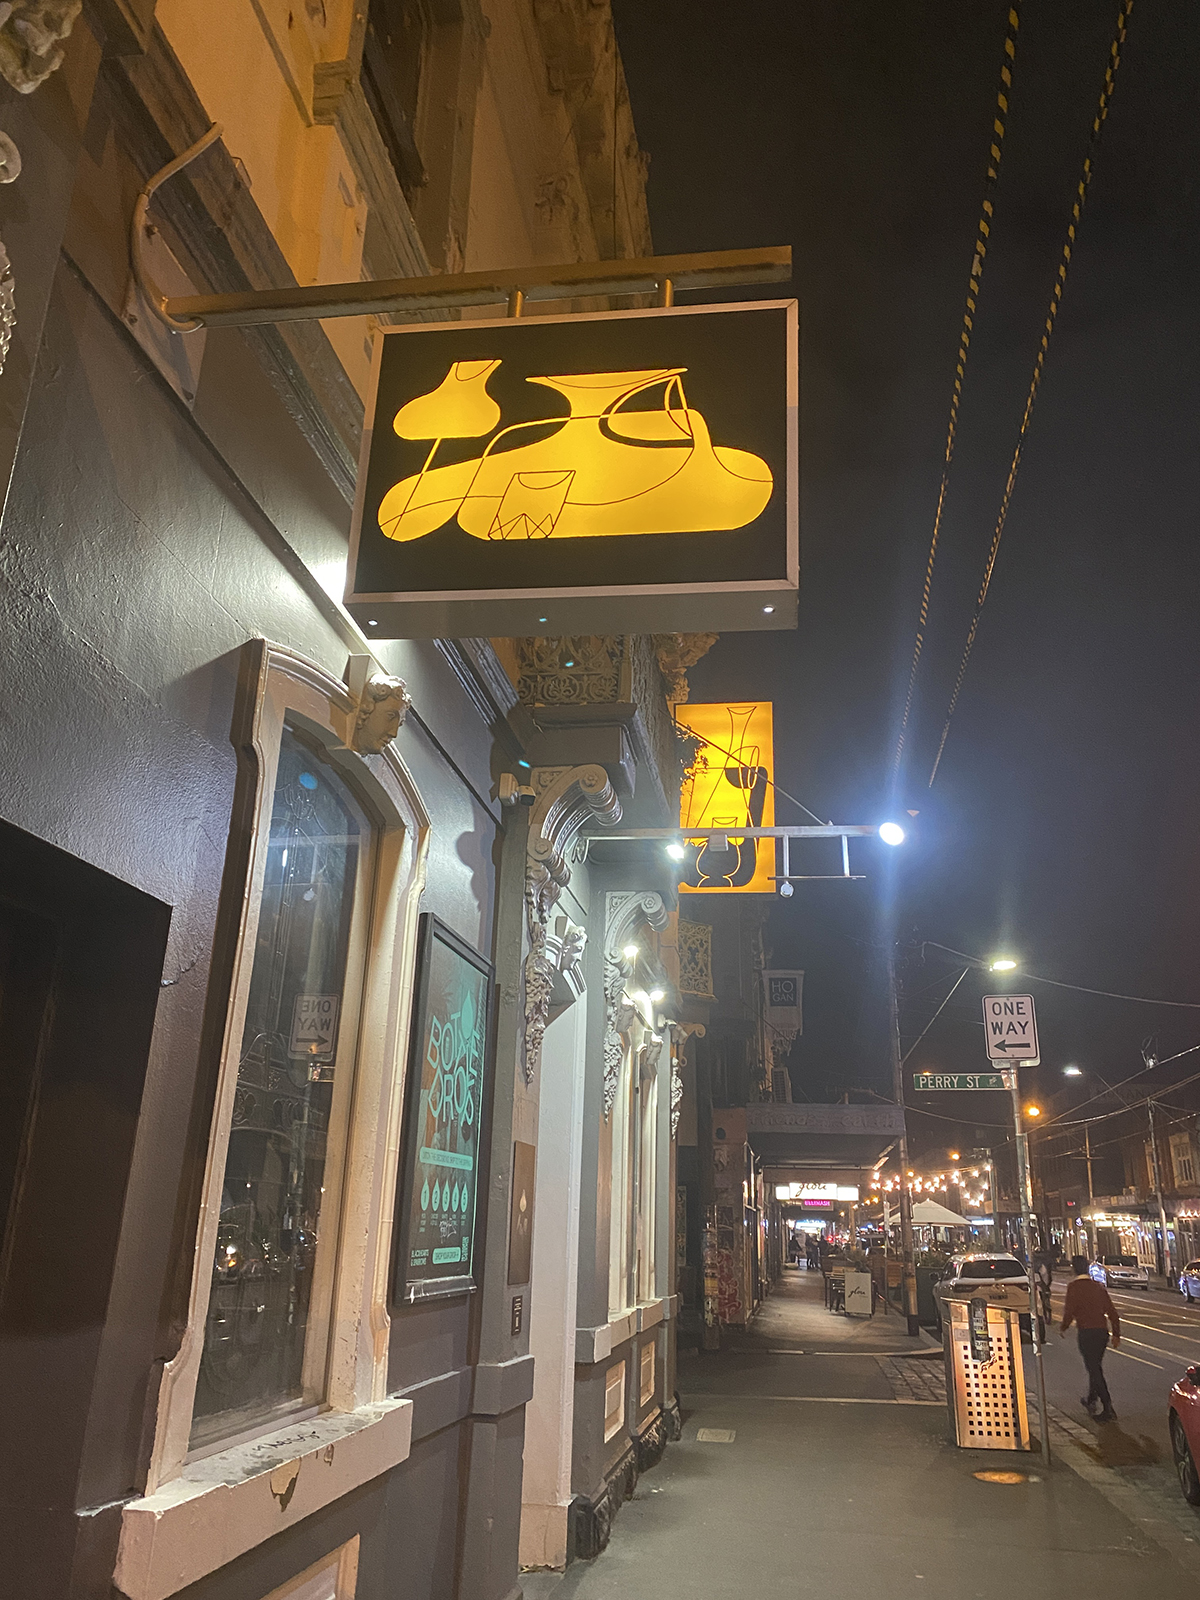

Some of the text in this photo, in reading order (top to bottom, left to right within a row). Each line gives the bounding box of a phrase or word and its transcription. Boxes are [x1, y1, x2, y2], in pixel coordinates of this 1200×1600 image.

[771, 980, 794, 993] HO
[772, 993, 794, 1002] GAN
[992, 1001, 1026, 1016] ONE
[991, 1020, 1029, 1035] WAY
[919, 1076, 981, 1088] PERRY ST
[428, 1065, 474, 1127] DROP
